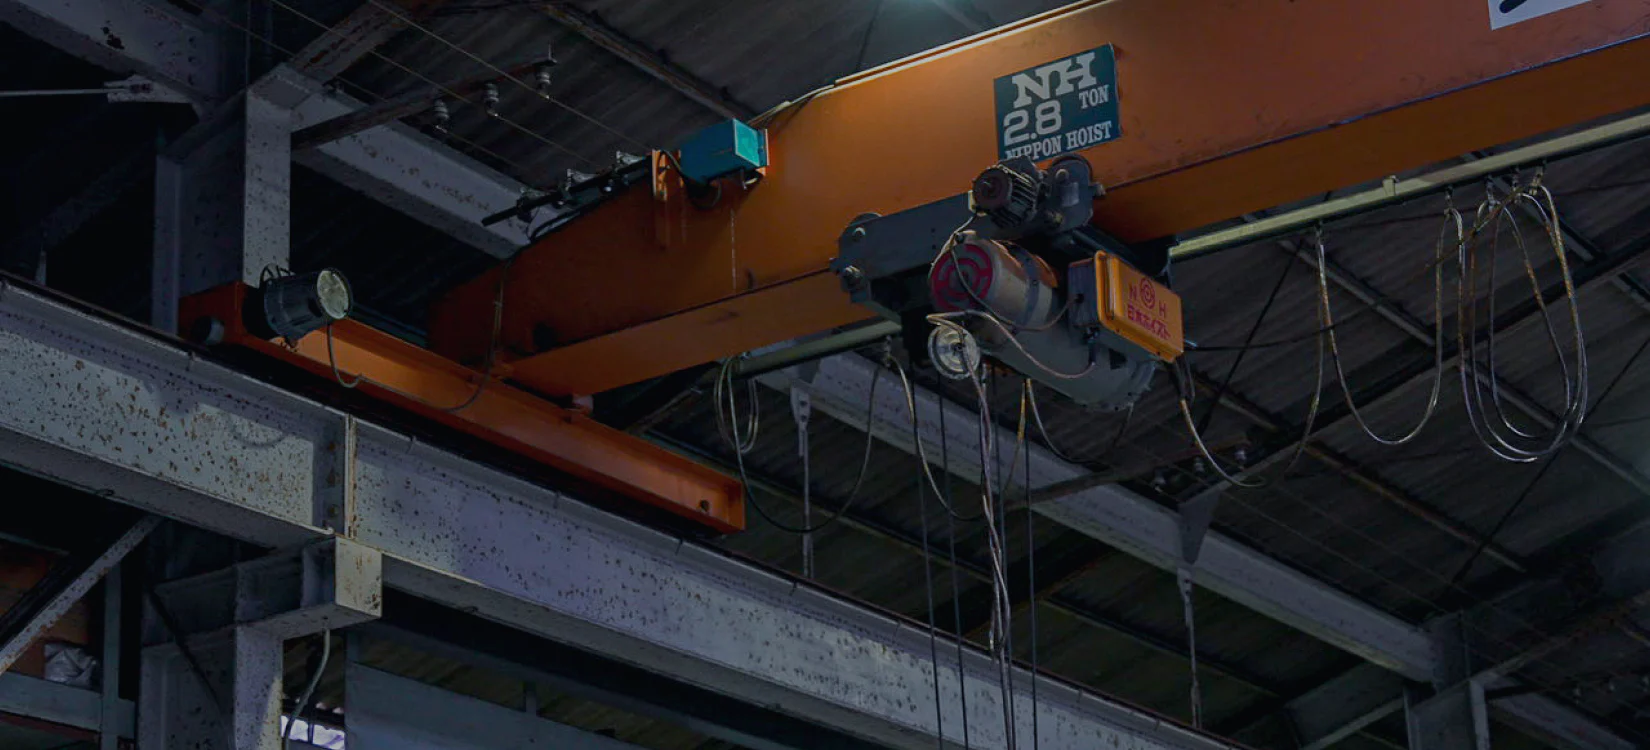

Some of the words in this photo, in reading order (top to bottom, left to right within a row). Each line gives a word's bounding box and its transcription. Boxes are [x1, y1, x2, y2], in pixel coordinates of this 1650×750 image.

[1011, 52, 1097, 108] NH
[1003, 100, 1062, 146] 2.8
[1079, 84, 1109, 109] TON
[1065, 121, 1112, 150] HOIST
